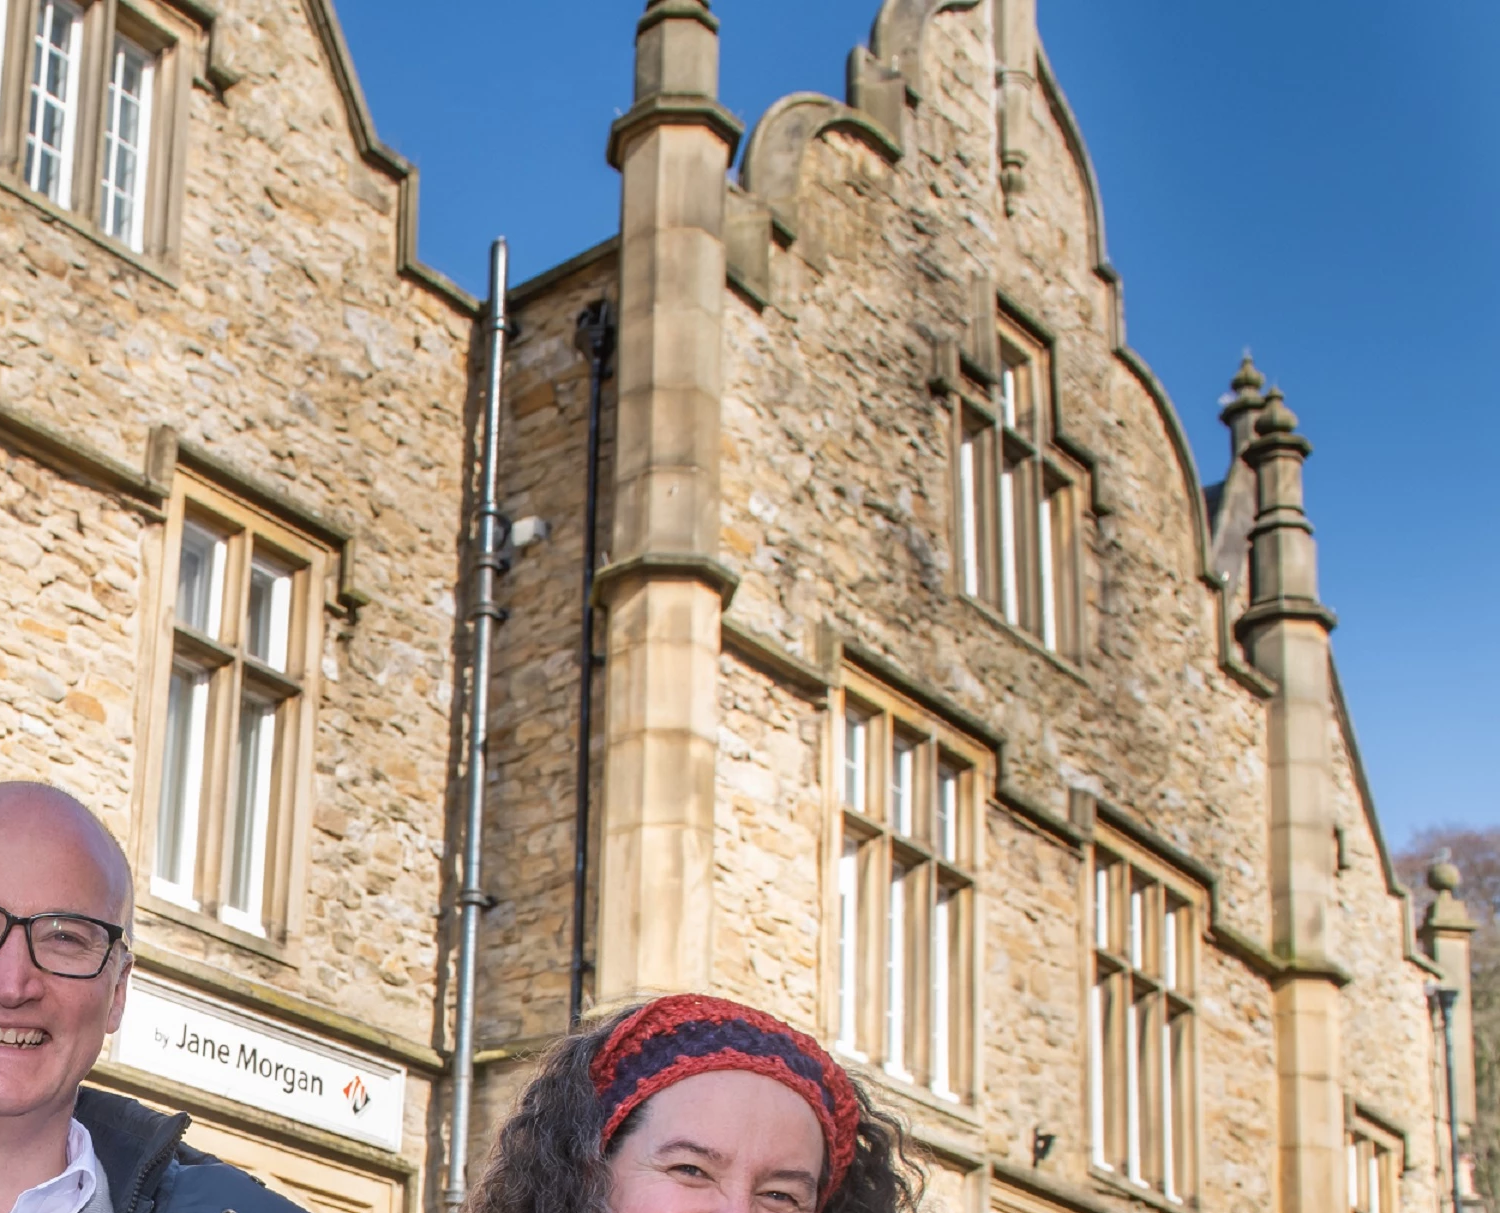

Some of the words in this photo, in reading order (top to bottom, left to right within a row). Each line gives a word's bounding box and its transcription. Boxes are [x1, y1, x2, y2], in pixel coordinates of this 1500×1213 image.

[154, 1027, 170, 1049] by
[175, 1023, 230, 1064] Jane
[236, 1043, 324, 1095] Morgan
